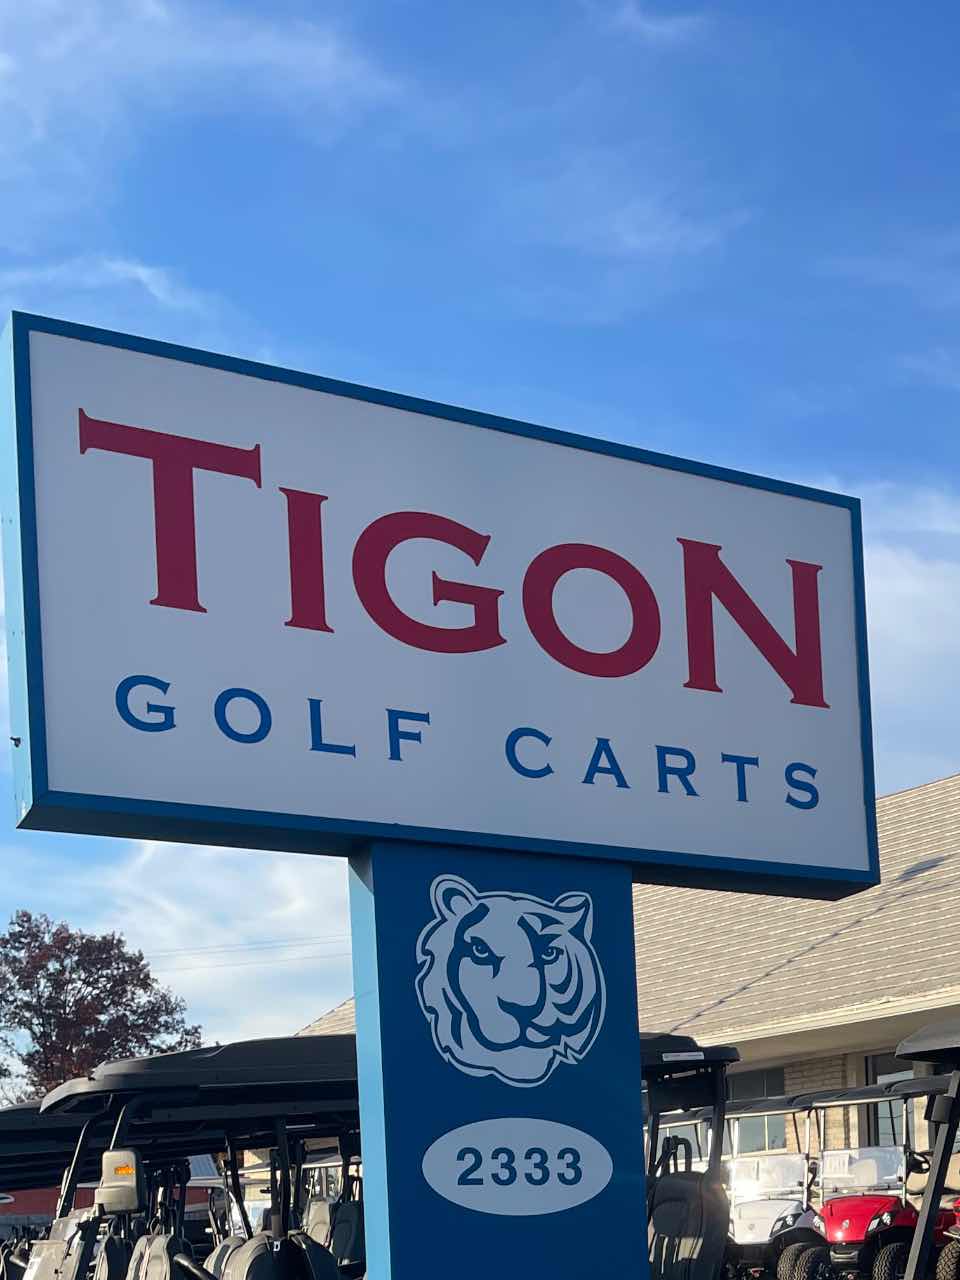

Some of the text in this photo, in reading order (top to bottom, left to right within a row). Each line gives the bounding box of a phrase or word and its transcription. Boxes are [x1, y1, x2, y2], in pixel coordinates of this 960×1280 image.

[79, 408, 830, 708] TIGON
[115, 674, 820, 811] GOLF CARTS
[456, 1147, 583, 1186] 2333
